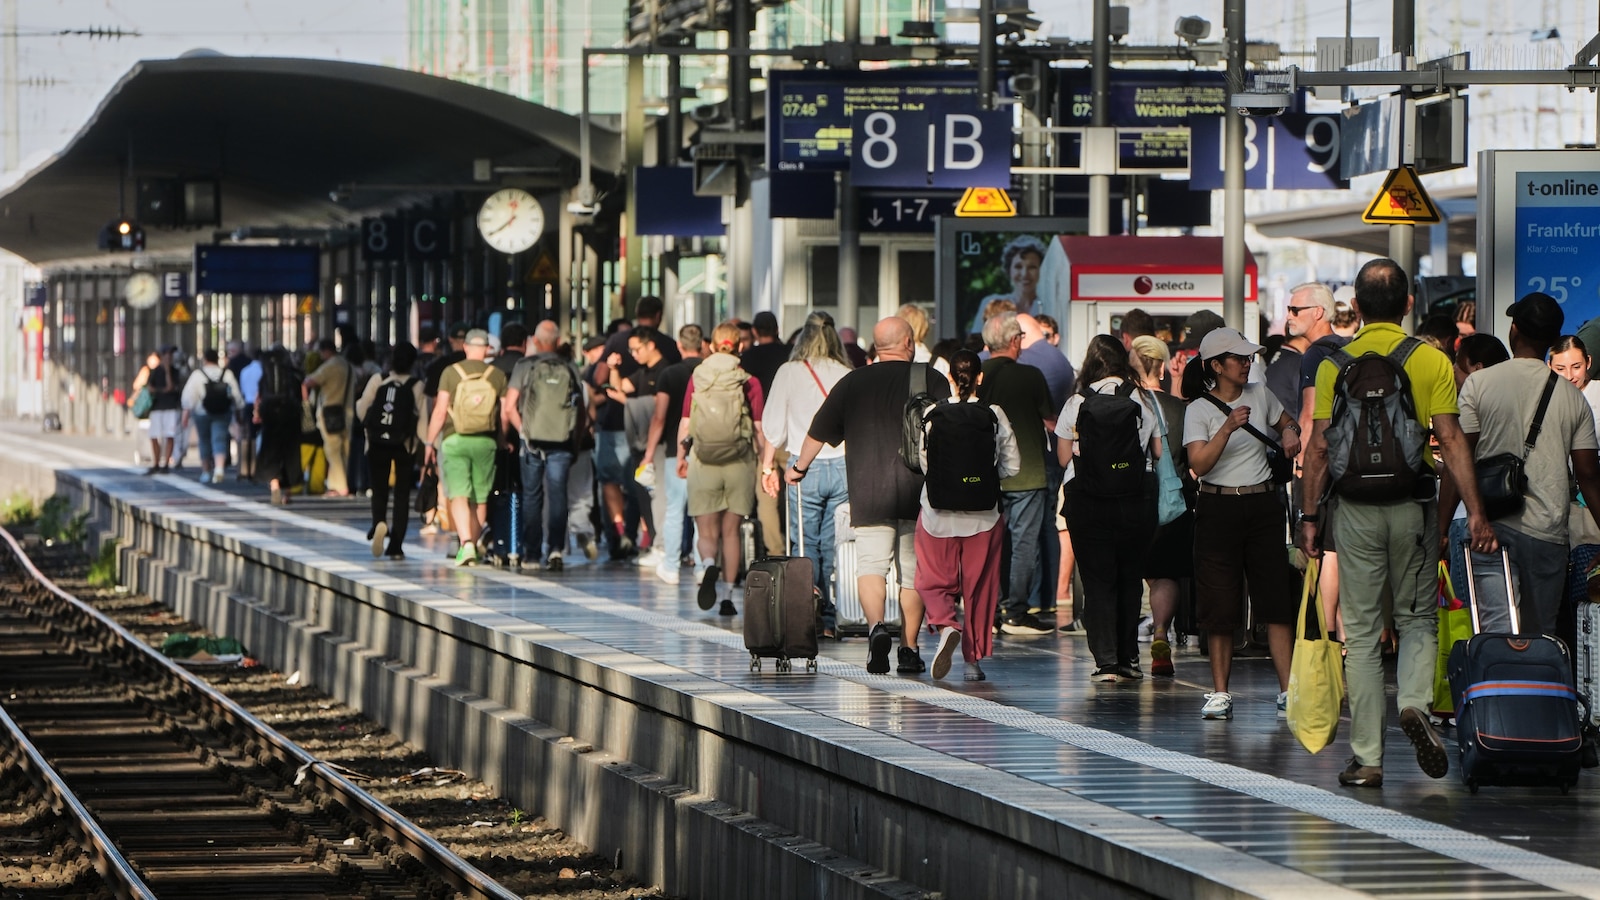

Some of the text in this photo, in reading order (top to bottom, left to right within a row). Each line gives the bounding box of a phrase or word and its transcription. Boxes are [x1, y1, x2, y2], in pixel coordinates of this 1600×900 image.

[782, 102, 818, 117] 07:46
[1072, 102, 1093, 117] 07:
[862, 111, 984, 170] 8 B
[1305, 116, 1340, 173] 9
[1527, 179, 1599, 196] t-online
[891, 199, 929, 221] 1-7
[368, 220, 436, 252] 8 C
[1527, 245, 1543, 253] Klar
[1550, 245, 1578, 255] Sonnig
[164, 271, 182, 298] E
[1155, 281, 1195, 291] selecta
[380, 411, 393, 426] 21
